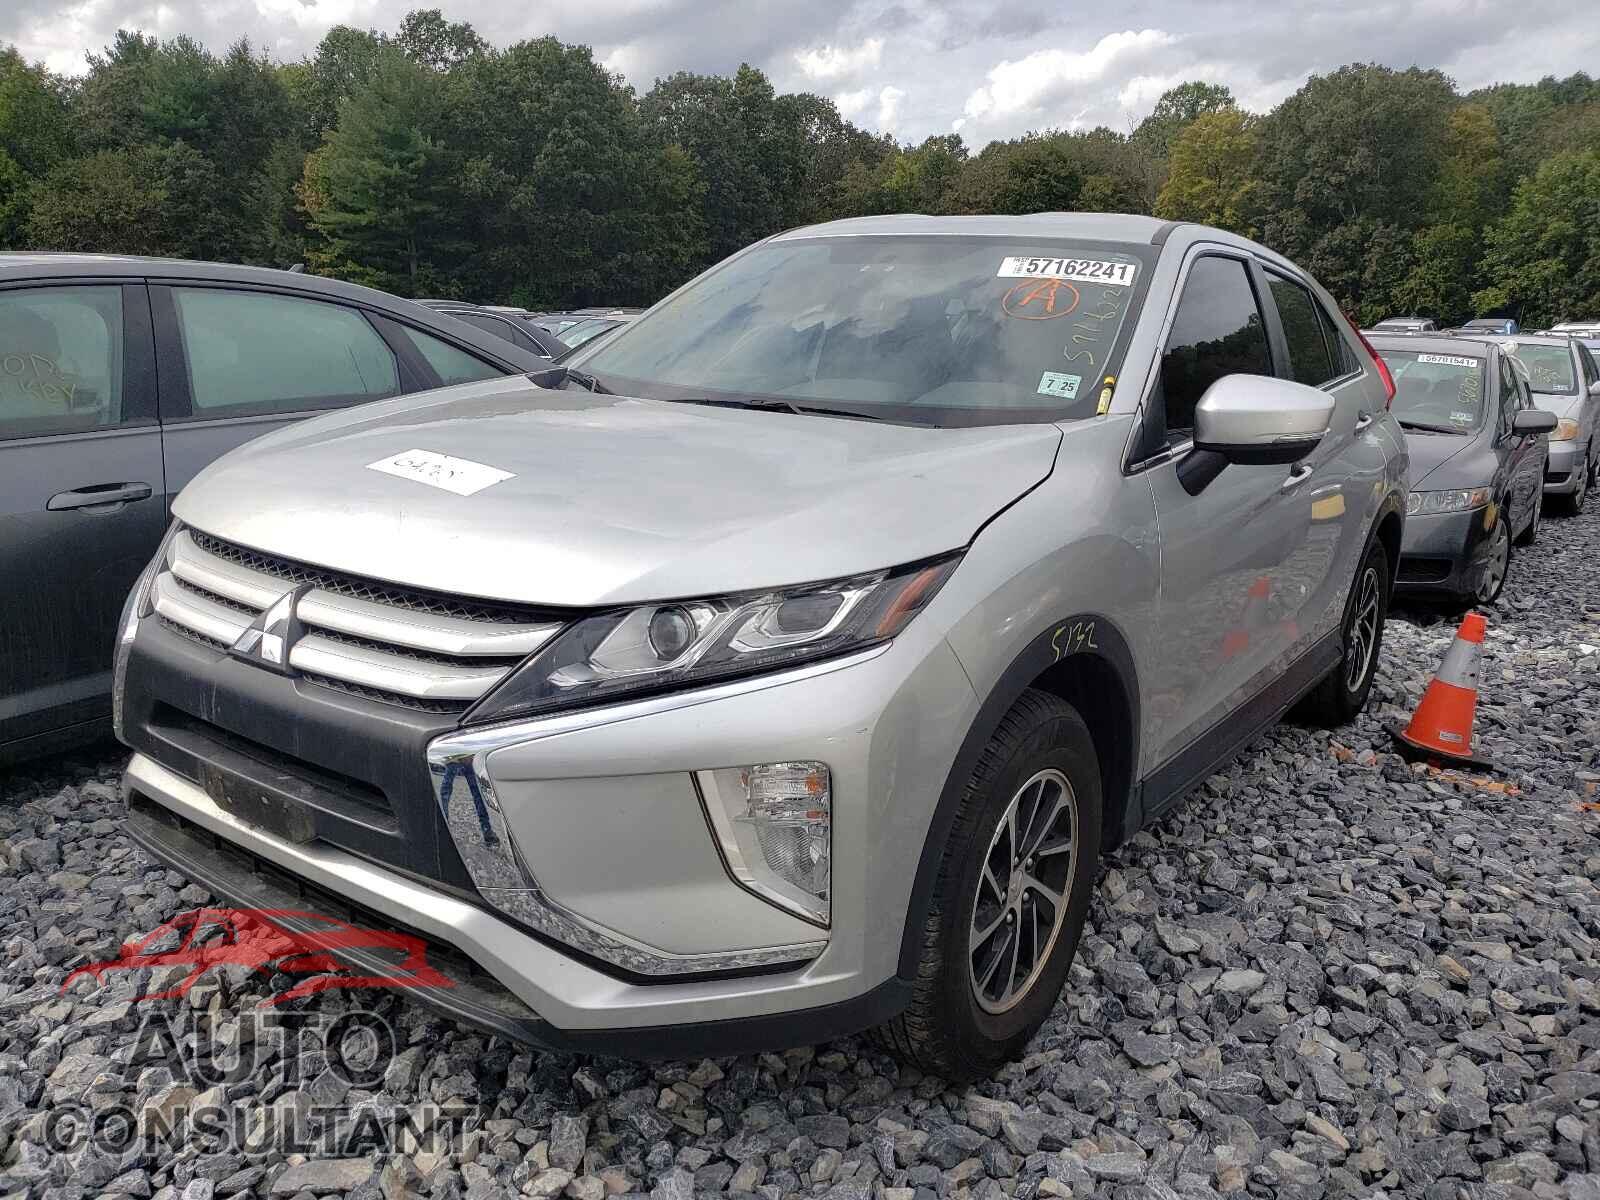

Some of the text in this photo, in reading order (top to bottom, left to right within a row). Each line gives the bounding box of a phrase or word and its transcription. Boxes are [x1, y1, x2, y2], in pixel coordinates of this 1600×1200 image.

[1027, 258, 1128, 281] 57162241
[1046, 378, 1075, 392] 7 25
